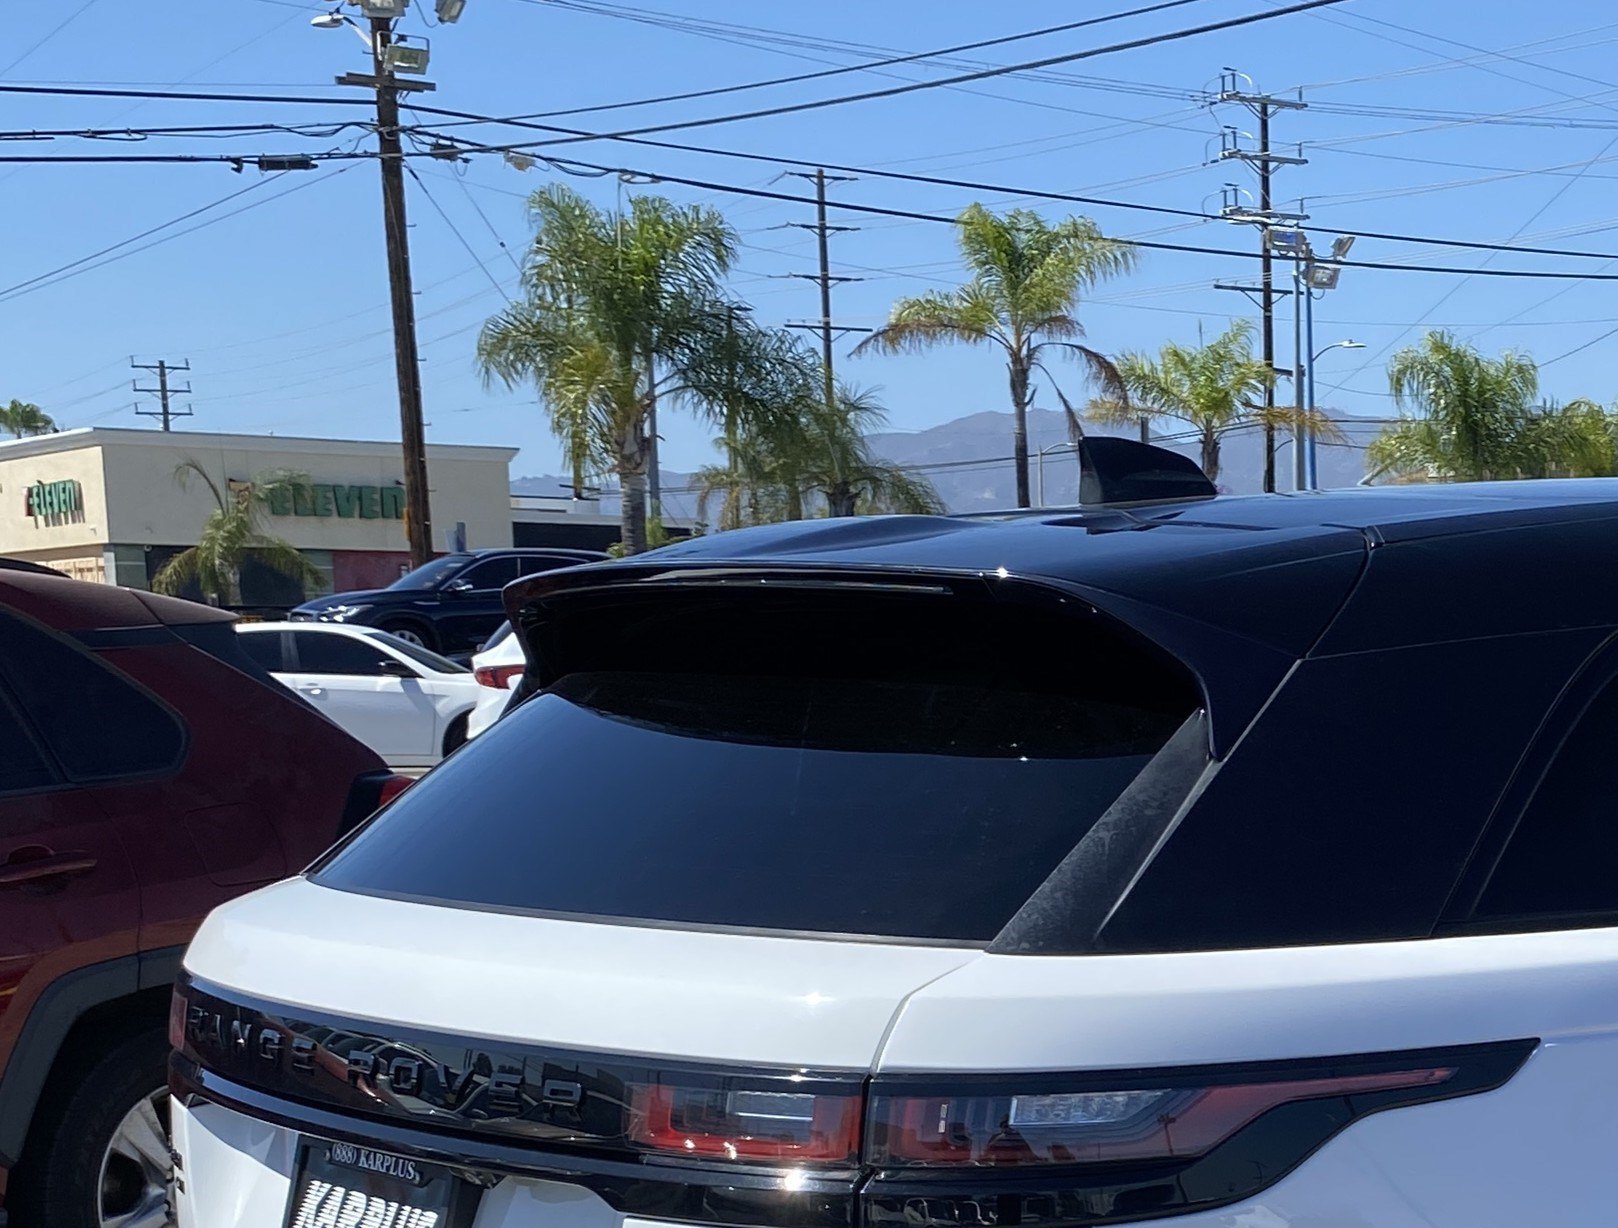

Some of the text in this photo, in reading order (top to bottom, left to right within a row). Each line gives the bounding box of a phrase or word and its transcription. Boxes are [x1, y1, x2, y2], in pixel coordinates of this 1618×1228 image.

[187, 1005, 582, 1122] RANGE ROVER
[331, 1143, 417, 1180] (888) KARPLUS
